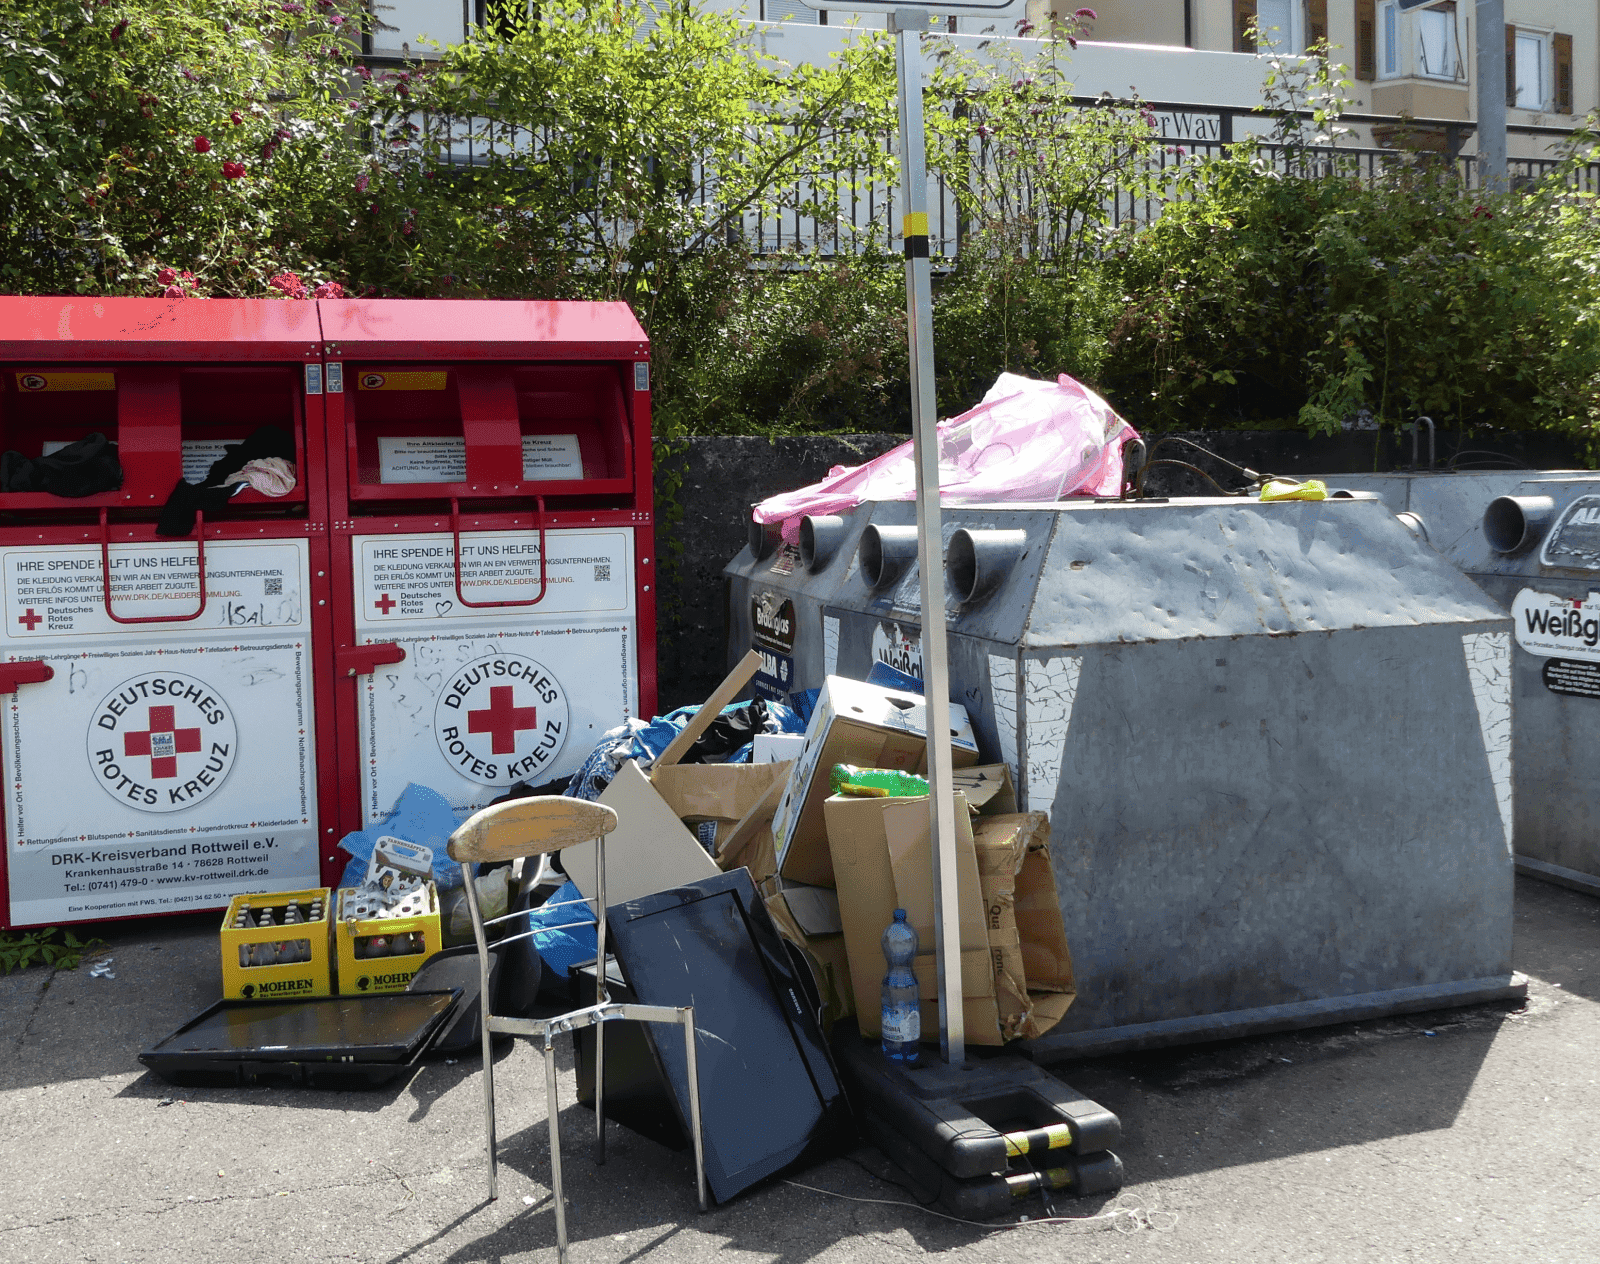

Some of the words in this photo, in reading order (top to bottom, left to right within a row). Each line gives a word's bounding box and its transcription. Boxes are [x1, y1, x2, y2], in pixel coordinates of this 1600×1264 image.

[1566, 508, 1600, 525] AL
[16, 561, 44, 571] IHRE
[48, 560, 95, 570] SPENDE
[98, 558, 130, 569] HLFT
[133, 558, 158, 568] UNS
[161, 556, 207, 567] HELFE!
[374, 549, 398, 559] IHRE
[401, 548, 443, 558] SPENDE
[446, 546, 475, 556] HFT
[478, 546, 499, 555] UNS
[508, 556, 612, 566] VERWERTNGSUNTERNEHMEN.
[74, 574, 121, 583] VERKAUEN
[168, 569, 284, 579] VERWERUNGSUNTERNEHMEN.
[460, 576, 574, 587] WW.DRK.DE/KLEIDERSAMLUNG.
[110, 590, 242, 602] WWW.DRK.DE/KLEIDERSMMLUNG.
[757, 606, 789, 636] Brauglas
[1525, 608, 1600, 646] Weißg
[19, 653, 81, 662] Erste-Hilfe-Lehrgänge
[240, 643, 293, 651] Betreuungsdienste
[444, 660, 558, 710] DEUTSCHES
[98, 679, 225, 731] DEUTSCHES
[13, 712, 22, 782] Bevölkerungsschutz
[443, 726, 498, 779] ROTES
[507, 720, 562, 778] KREUZ
[96, 749, 158, 804] ROTES
[168, 742, 229, 804] KREUZ
[299, 737, 307, 815] Notfallnachsorgedienst
[27, 836, 78, 845] Rettungsdienst
[88, 833, 126, 841] Blutspende
[136, 828, 187, 837] Sanitätsdienste
[197, 823, 248, 832] Jugendrotkreuz
[258, 818, 298, 827] Kleiderladen
[52, 845, 186, 865] DRK-Kreisverband
[192, 840, 249, 854] Rottweil
[254, 838, 278, 849] e.V.
[66, 863, 168, 878] Krankenhausstraße
[194, 858, 224, 867] 78628
[227, 854, 268, 864] Rottweil
[64, 884, 85, 892] Tel.:
[88, 881, 117, 892] (0741)
[121, 878, 148, 887] 479-0
[157, 868, 269, 884] www.kv-rottweil.drk.de
[85, 901, 126, 911] Kooperation
[259, 979, 314, 992] MOHREN
